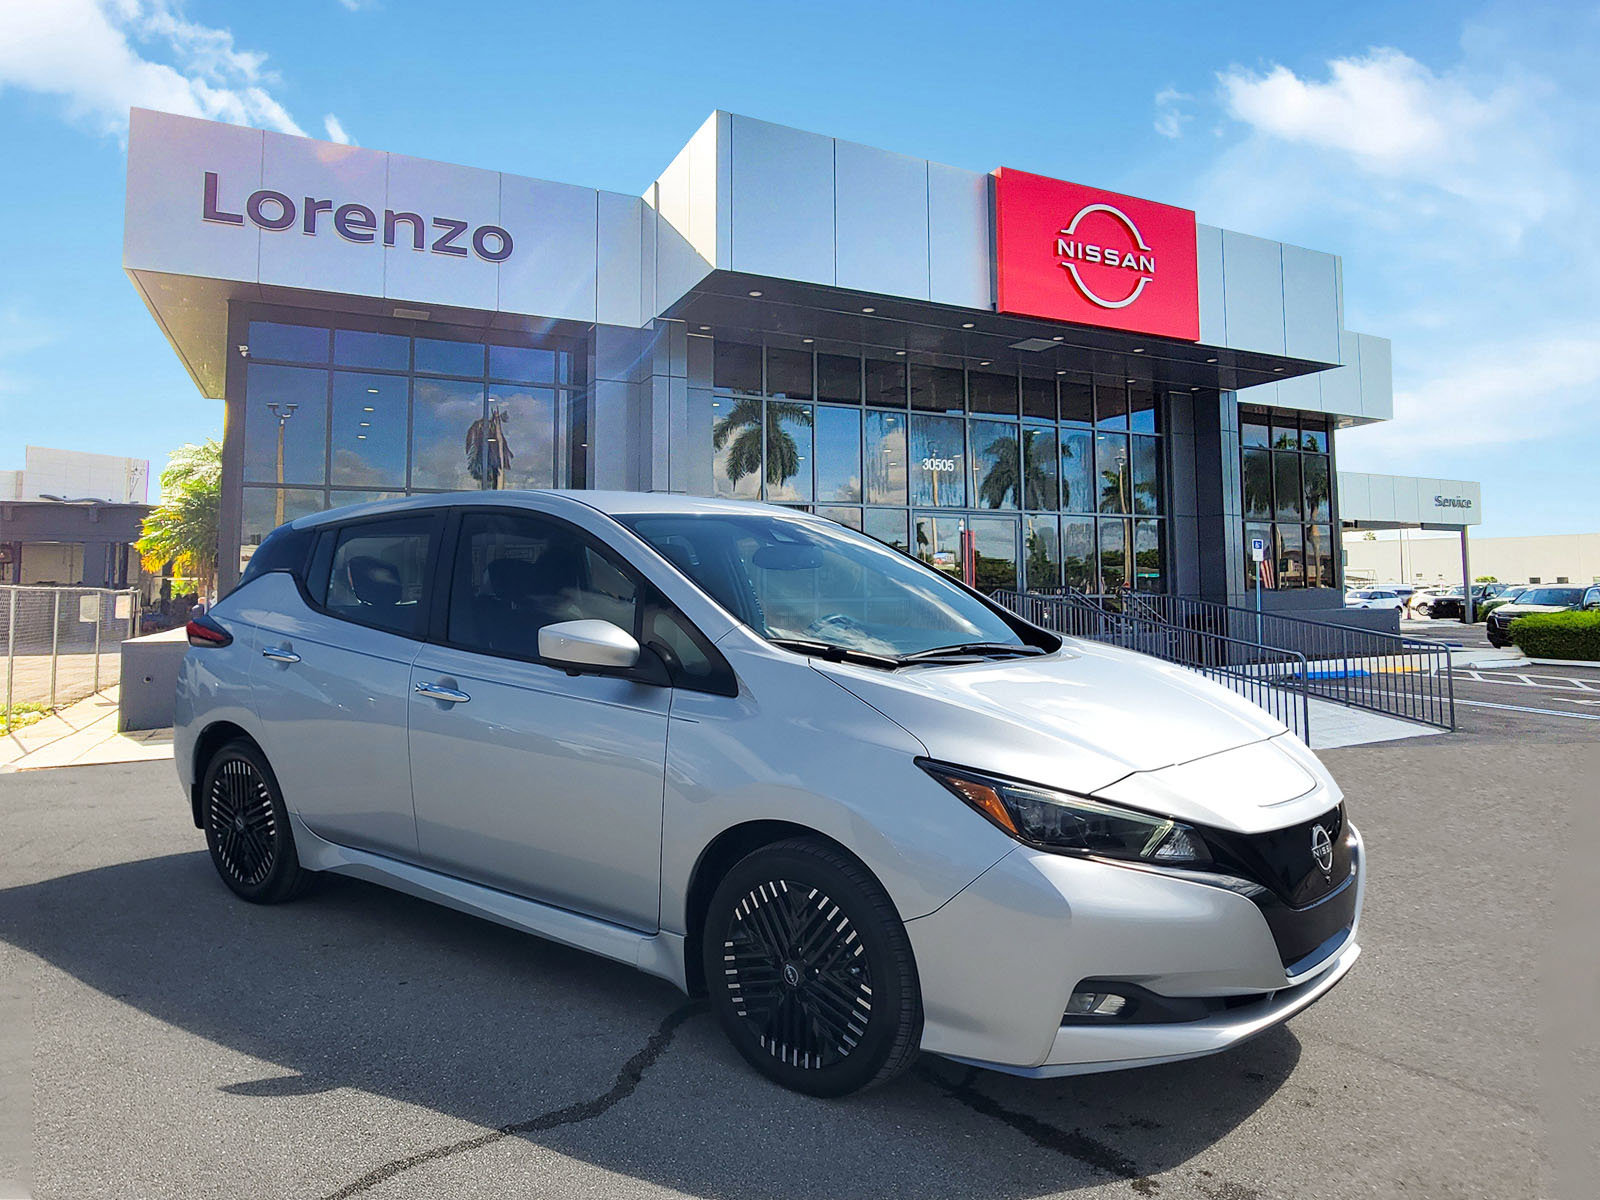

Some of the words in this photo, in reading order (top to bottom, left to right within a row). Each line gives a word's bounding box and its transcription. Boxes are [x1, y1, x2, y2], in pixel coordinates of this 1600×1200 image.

[202, 171, 514, 262] Lorenzo
[1057, 238, 1155, 273] NISSAN
[922, 458, 954, 471] 30505
[1434, 496, 1472, 508] Service
